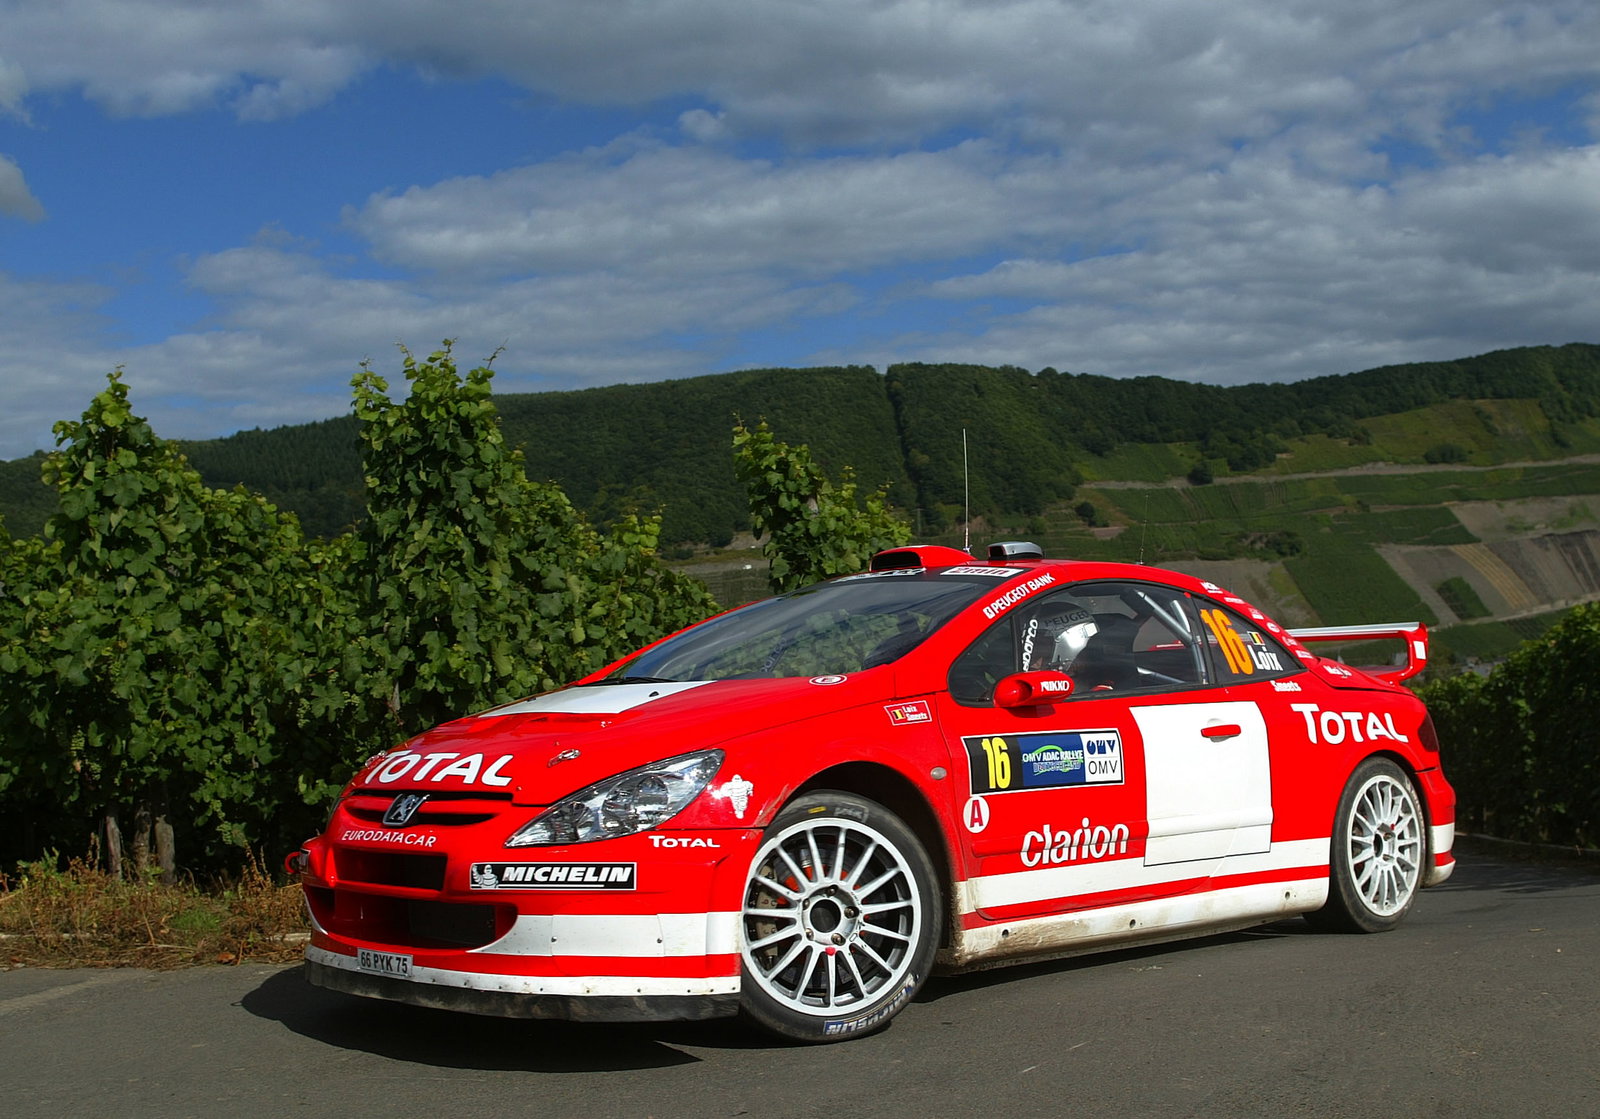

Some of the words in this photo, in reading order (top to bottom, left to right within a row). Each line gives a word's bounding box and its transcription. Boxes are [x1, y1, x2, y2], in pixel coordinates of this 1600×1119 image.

[991, 583, 1030, 615] PEUGEOT
[1029, 572, 1056, 590] BANK
[1200, 609, 1254, 675] 16
[1247, 644, 1283, 671] Loix
[1040, 680, 1070, 692] NIKKO
[1270, 680, 1302, 692] Smeets
[1290, 703, 1409, 745] TOTAL
[981, 736, 1011, 790] 16
[1022, 753, 1042, 763] OMV
[1042, 751, 1060, 761] ADAC
[1060, 749, 1084, 760] RALLYE
[1088, 760, 1118, 775] OMV
[364, 750, 513, 787] TOTAL
[970, 800, 983, 827] A
[341, 829, 437, 848] EURODATACAR
[648, 835, 721, 848] TOTAL
[502, 866, 632, 883] MICHELIN
[361, 951, 371, 968] 66
[373, 953, 393, 972] PYK
[395, 957, 408, 974] 75
